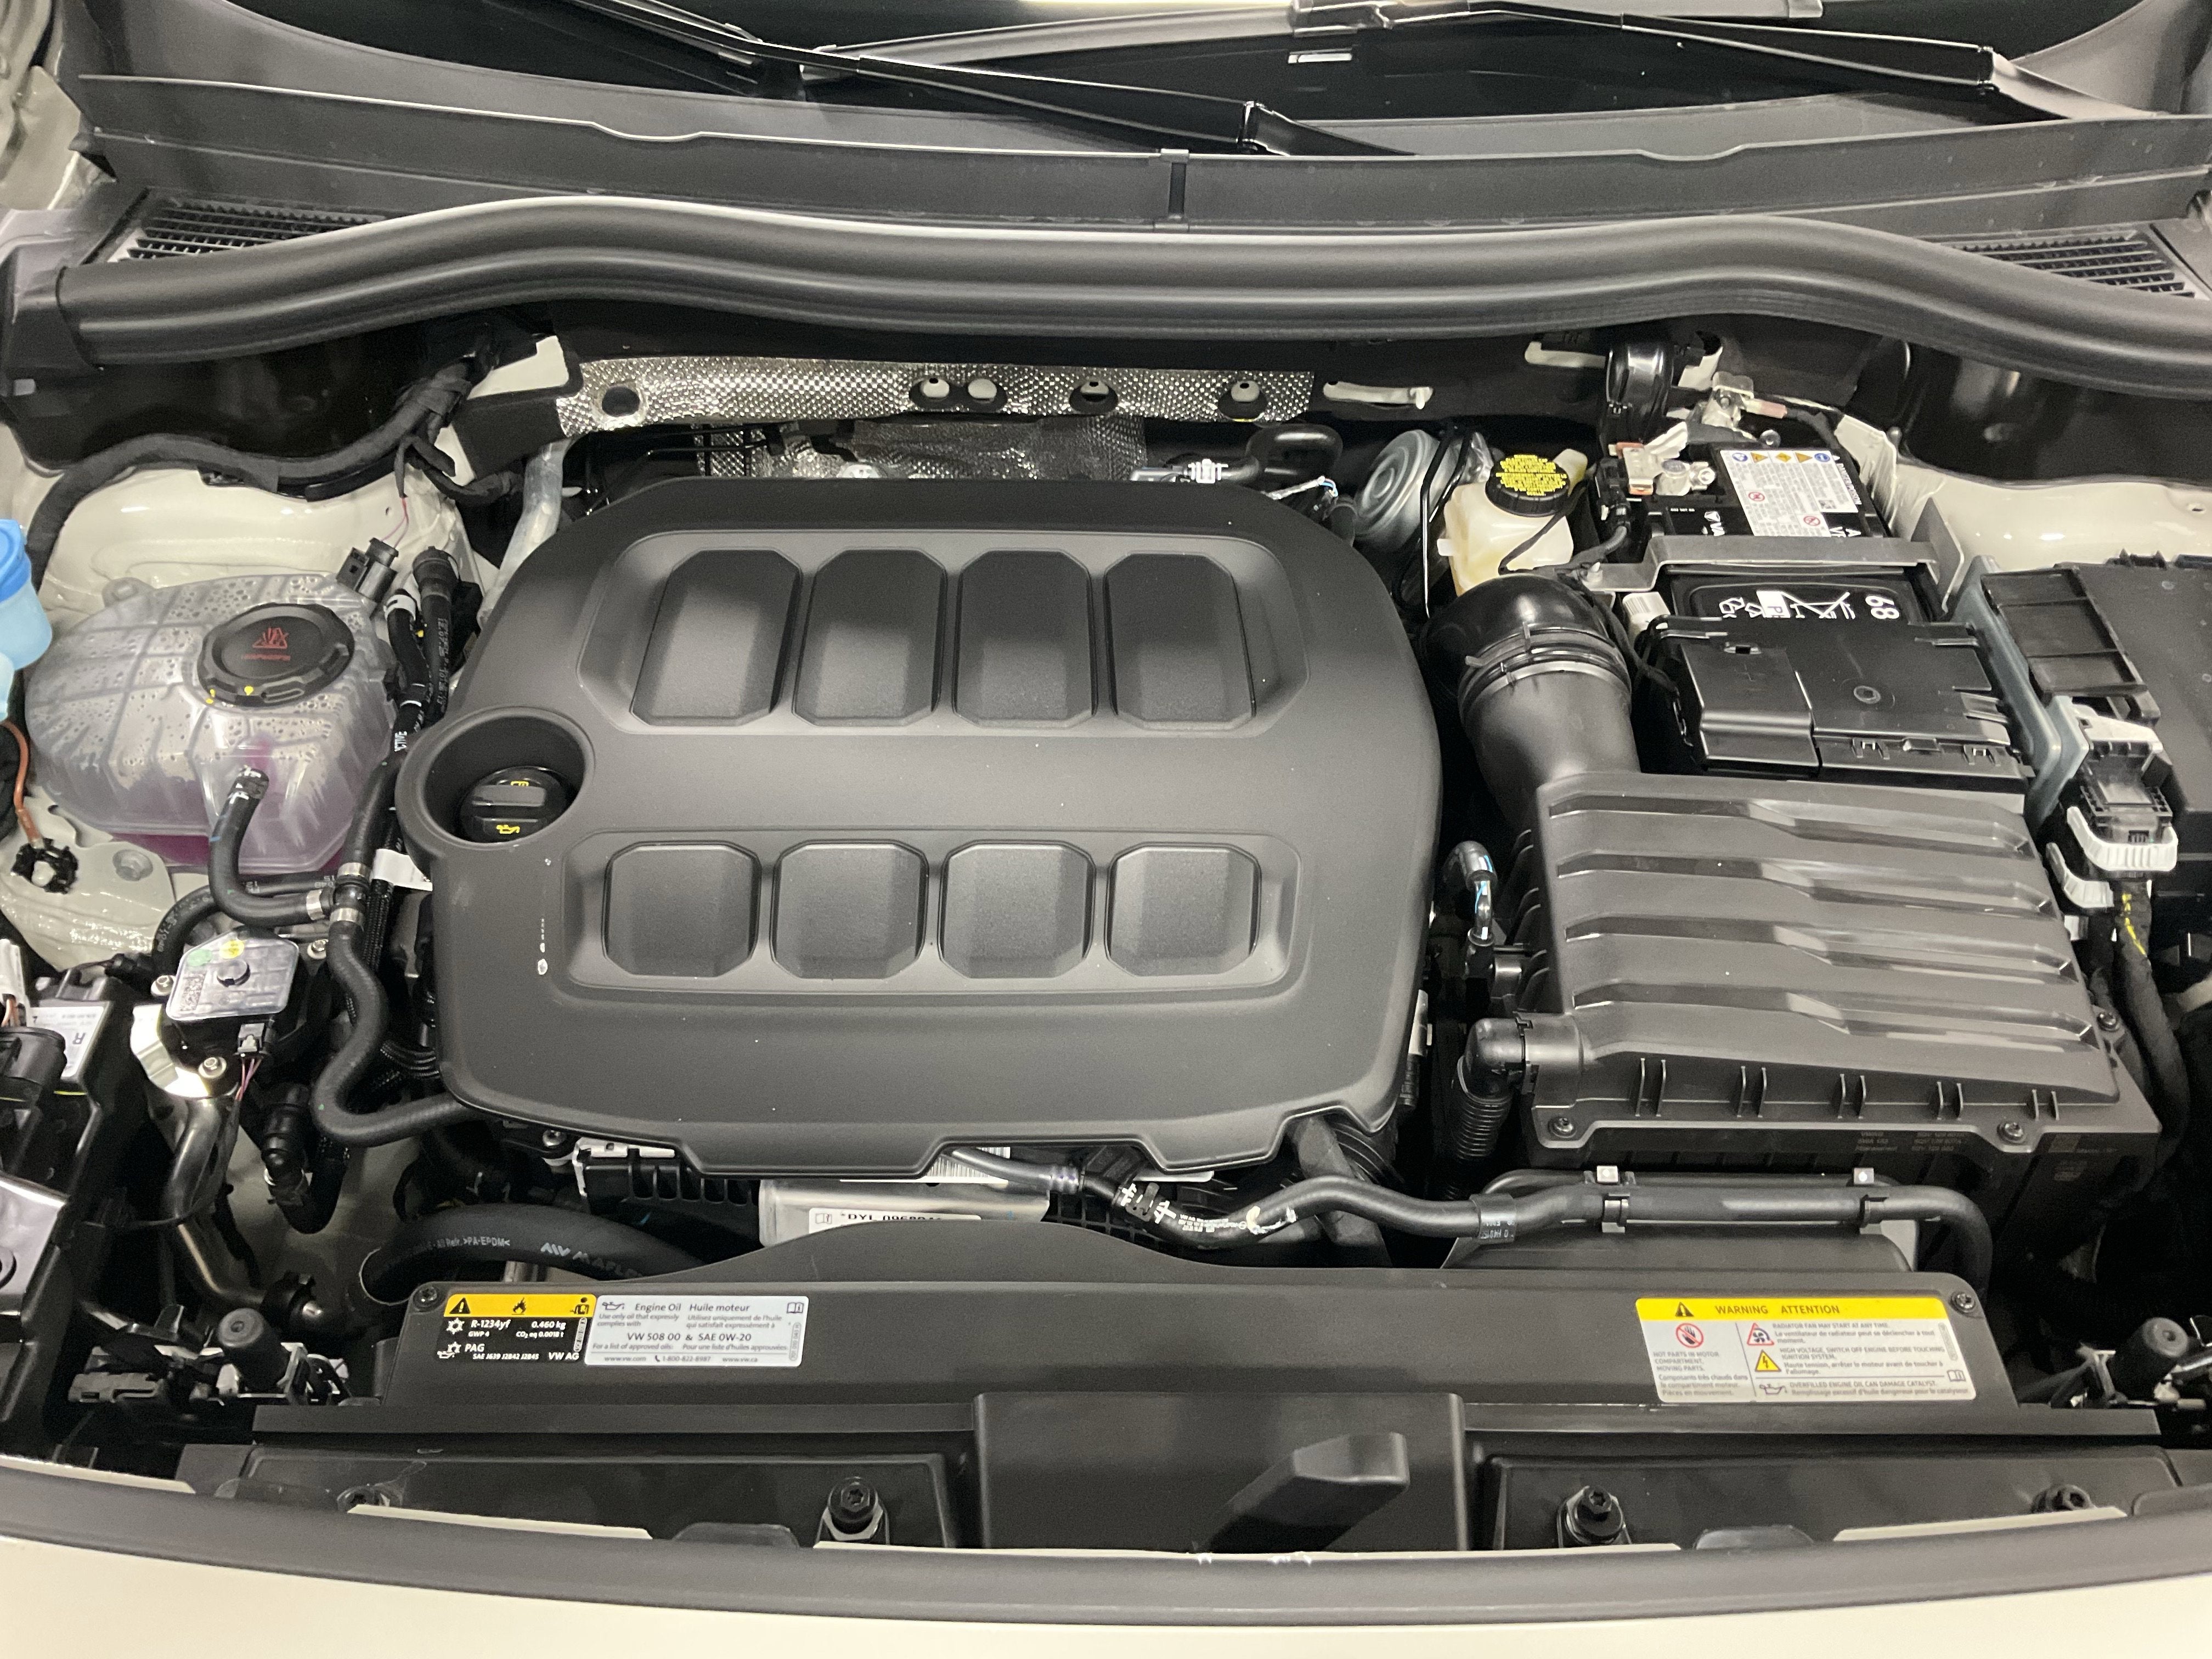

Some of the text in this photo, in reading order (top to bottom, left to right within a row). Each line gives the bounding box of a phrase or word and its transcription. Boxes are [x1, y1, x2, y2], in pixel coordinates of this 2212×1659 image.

[1865, 595, 1900, 619] 68
[635, 1304, 666, 1313] Engine
[668, 1303, 681, 1311] Oil
[1715, 1306, 1841, 1314] WARNING ATTENTION
[471, 1319, 511, 1330] R-1234yf
[556, 1321, 566, 1330] kg
